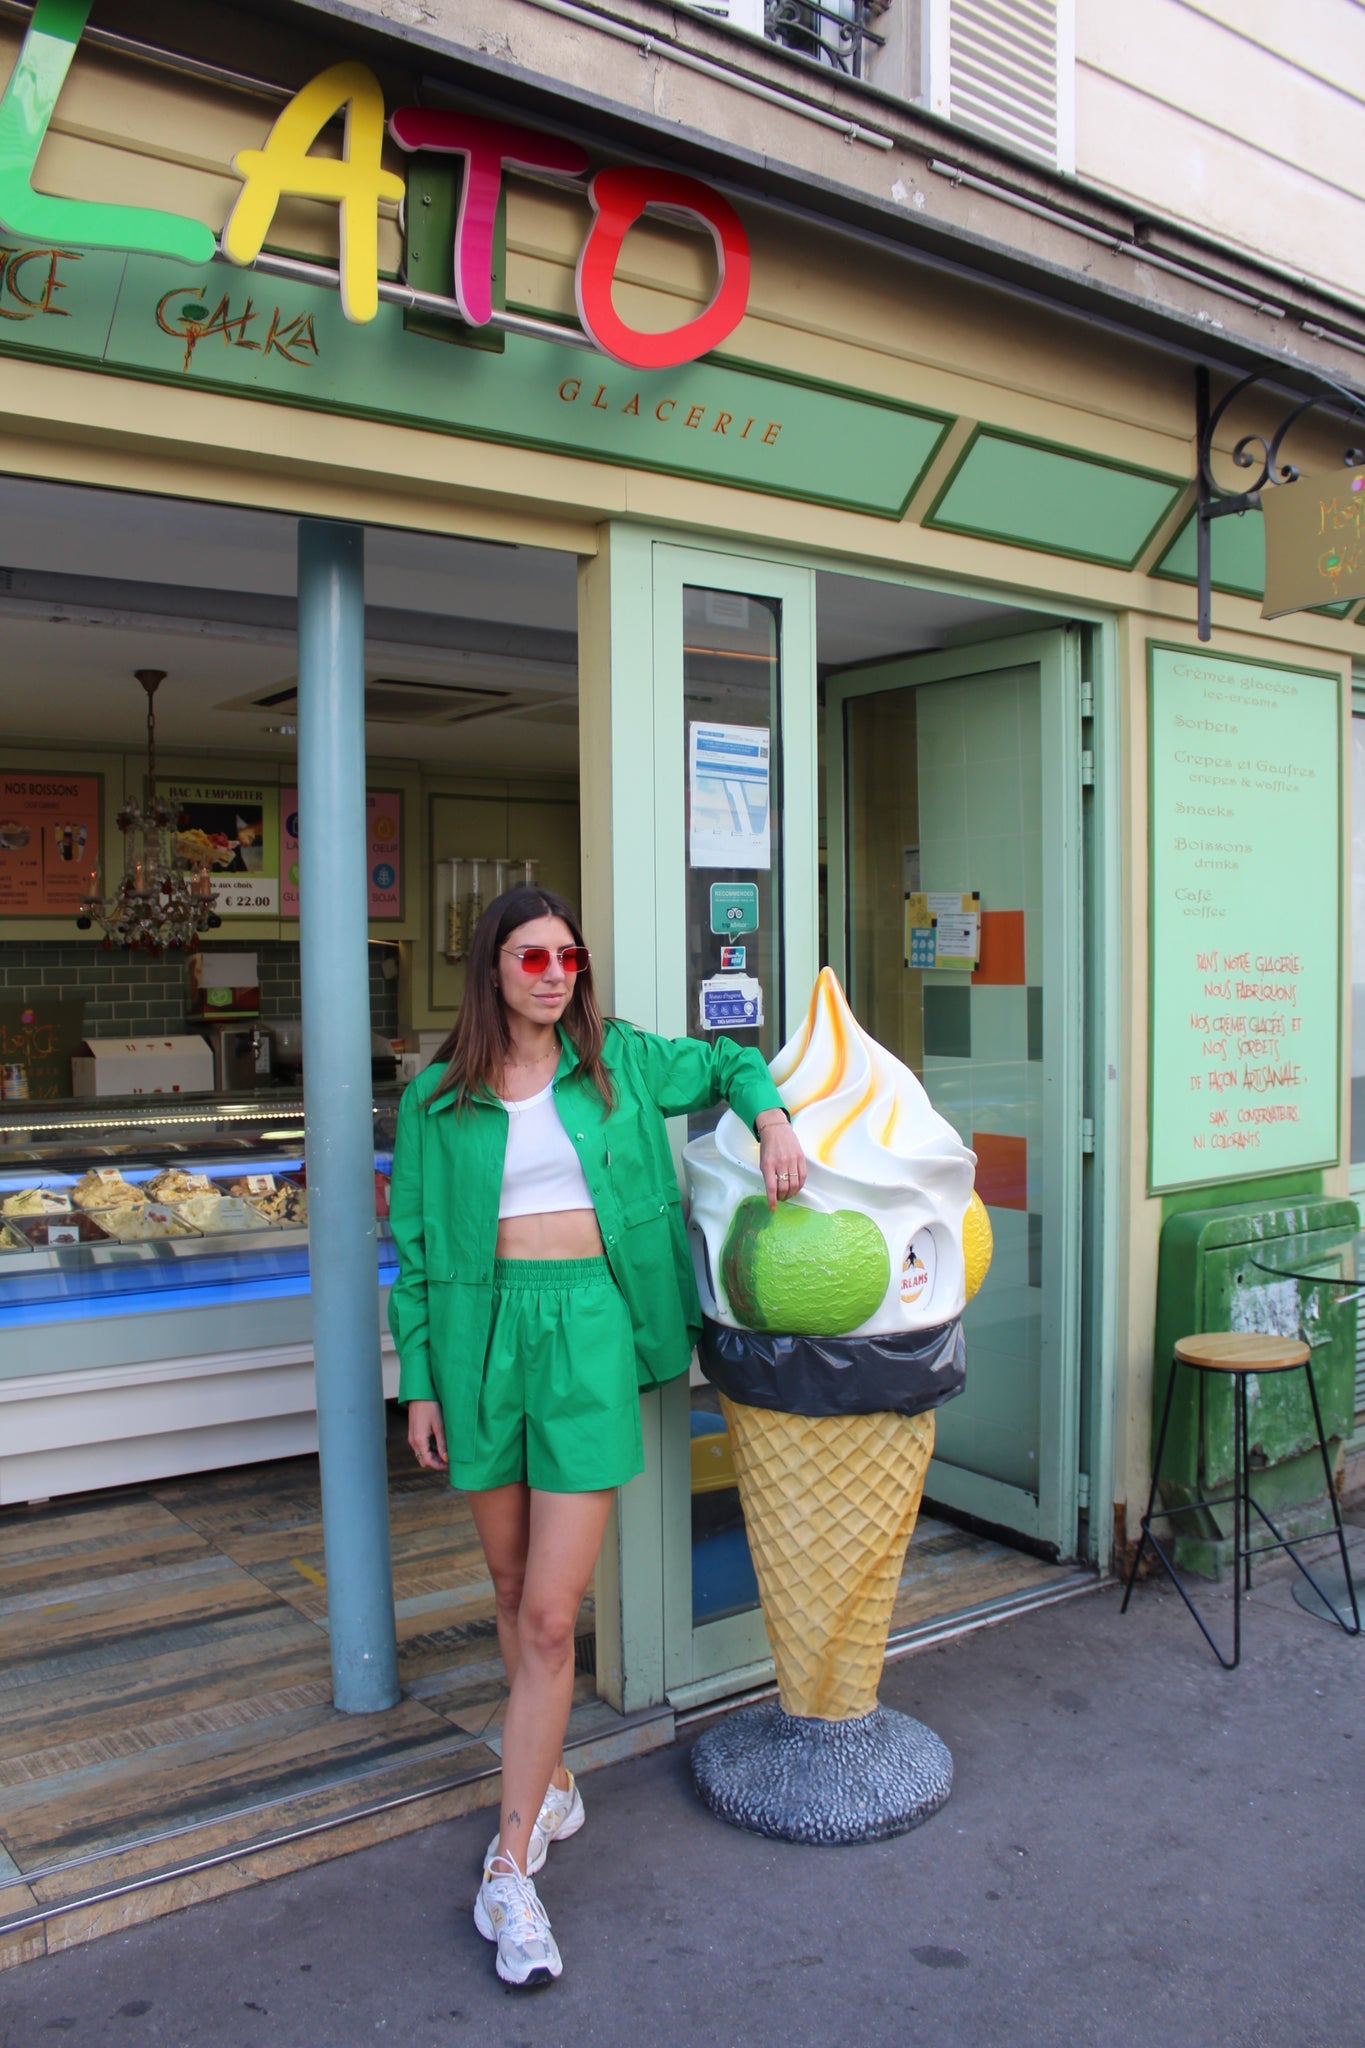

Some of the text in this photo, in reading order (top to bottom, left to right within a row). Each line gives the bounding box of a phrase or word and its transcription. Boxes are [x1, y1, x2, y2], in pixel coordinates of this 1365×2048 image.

[155, 286, 320, 372] GALKA
[558, 378, 782, 445] GLACERIE
[1174, 714, 1238, 734] Sorbets
[1238, 760, 1251, 770] et
[1256, 759, 1316, 777] Gaufres
[5, 783, 79, 797] NOS BOISSONS
[1241, 778, 1251, 788] &
[1255, 780, 1300, 793] waffles
[169, 787, 191, 798] BAC
[205, 790, 263, 801] EMPORTER
[1175, 801, 1234, 817] Snacks
[1174, 837, 1253, 853] Boissons
[1194, 858, 1239, 869] drinks
[233, 881, 253, 889] choix
[225, 895, 233, 906] €
[237, 896, 270, 907] 22.00
[372, 893, 397, 903] SOJA
[1174, 888, 1212, 903] Café
[1183, 905, 1227, 918] coffee
[1204, 979, 1231, 1000] NOUS
[1190, 1013, 1210, 1034] NOS
[1291, 1017, 1302, 1032] ET
[1203, 1038, 1280, 1063] NOS SORBETS
[1190, 1075, 1202, 1091] DE
[1193, 1130, 1261, 1152] NI COLORANTS
